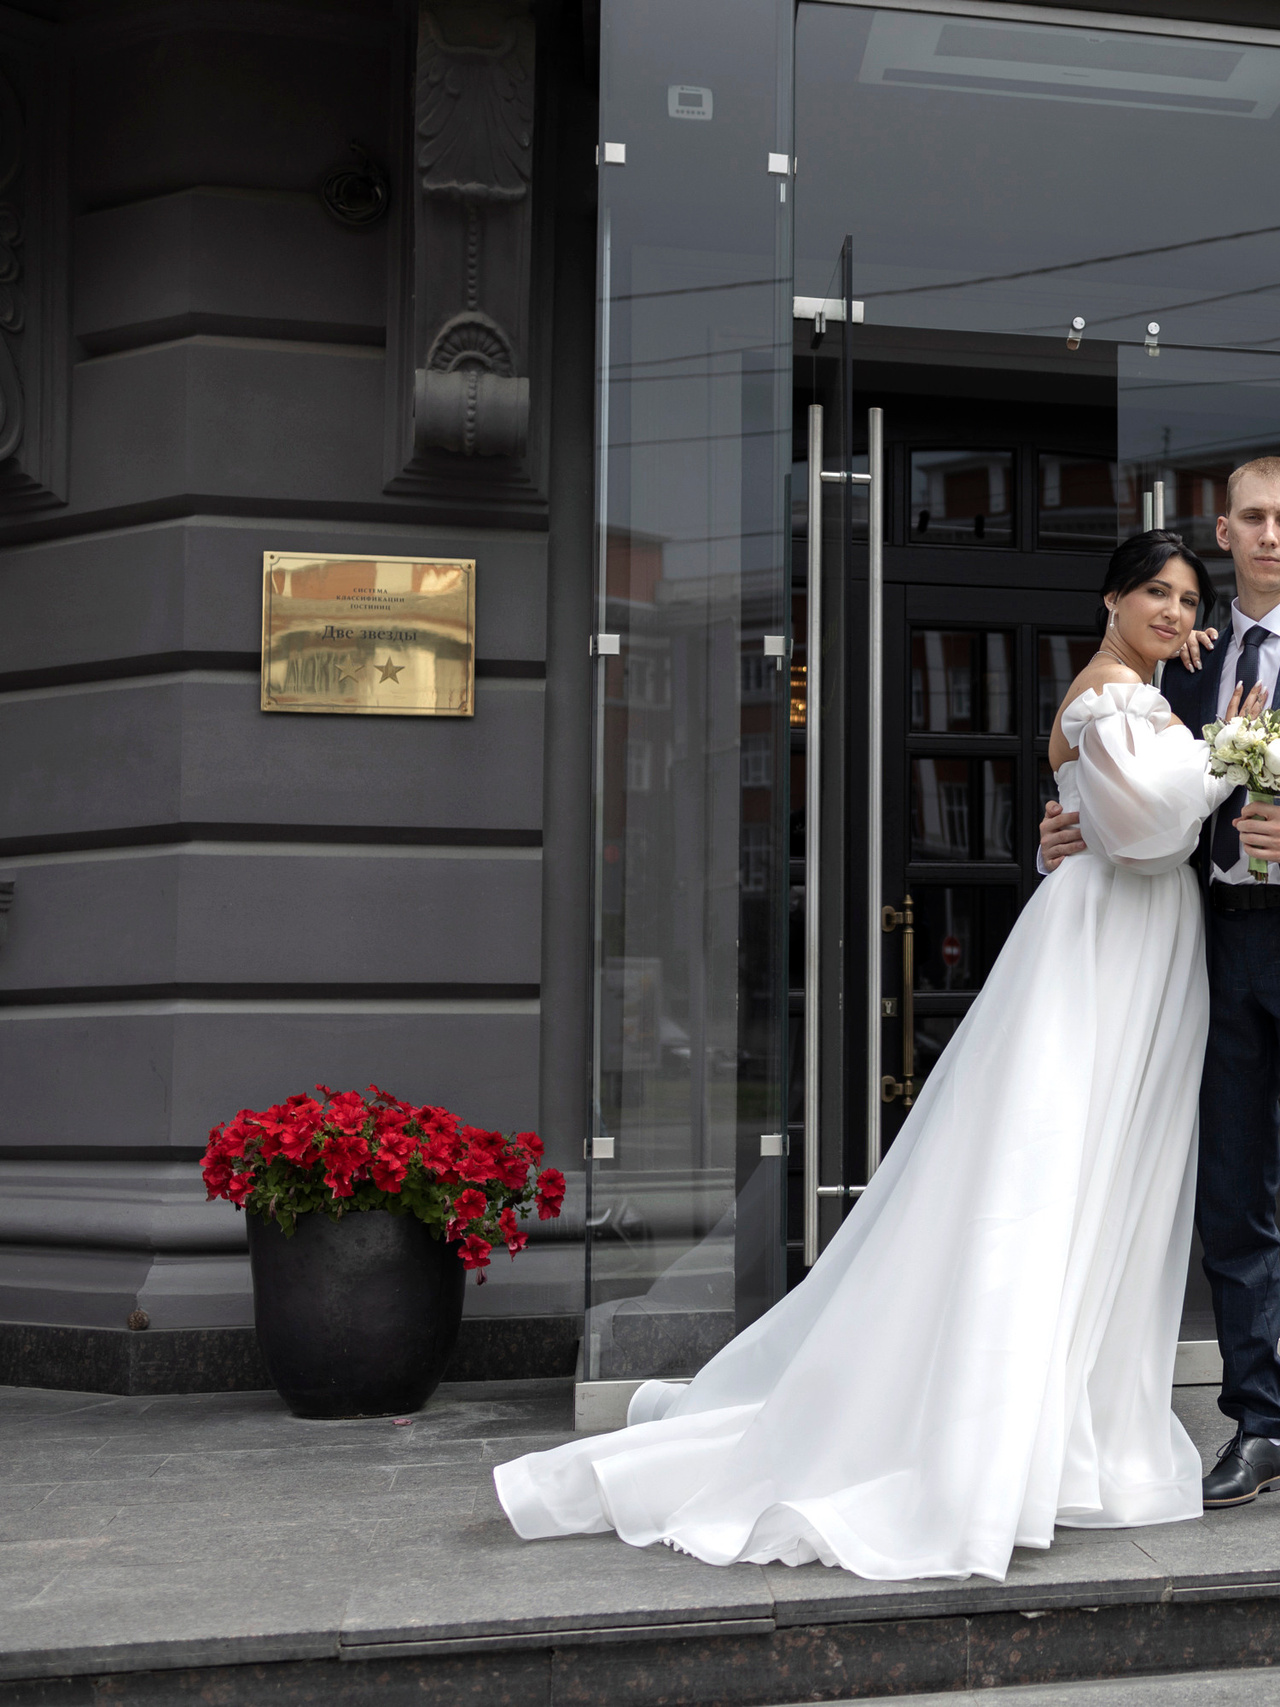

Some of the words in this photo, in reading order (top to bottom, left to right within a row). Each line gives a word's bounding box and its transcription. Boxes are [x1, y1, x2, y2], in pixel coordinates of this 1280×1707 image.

[353, 587, 388, 595] СИСТЕМА
[336, 595, 405, 603] КЛАССИФИКАЦИИ
[350, 603, 391, 611] ГОСТИНИЦ
[322, 625, 354, 641] Две
[359, 627, 417, 642] звезды
